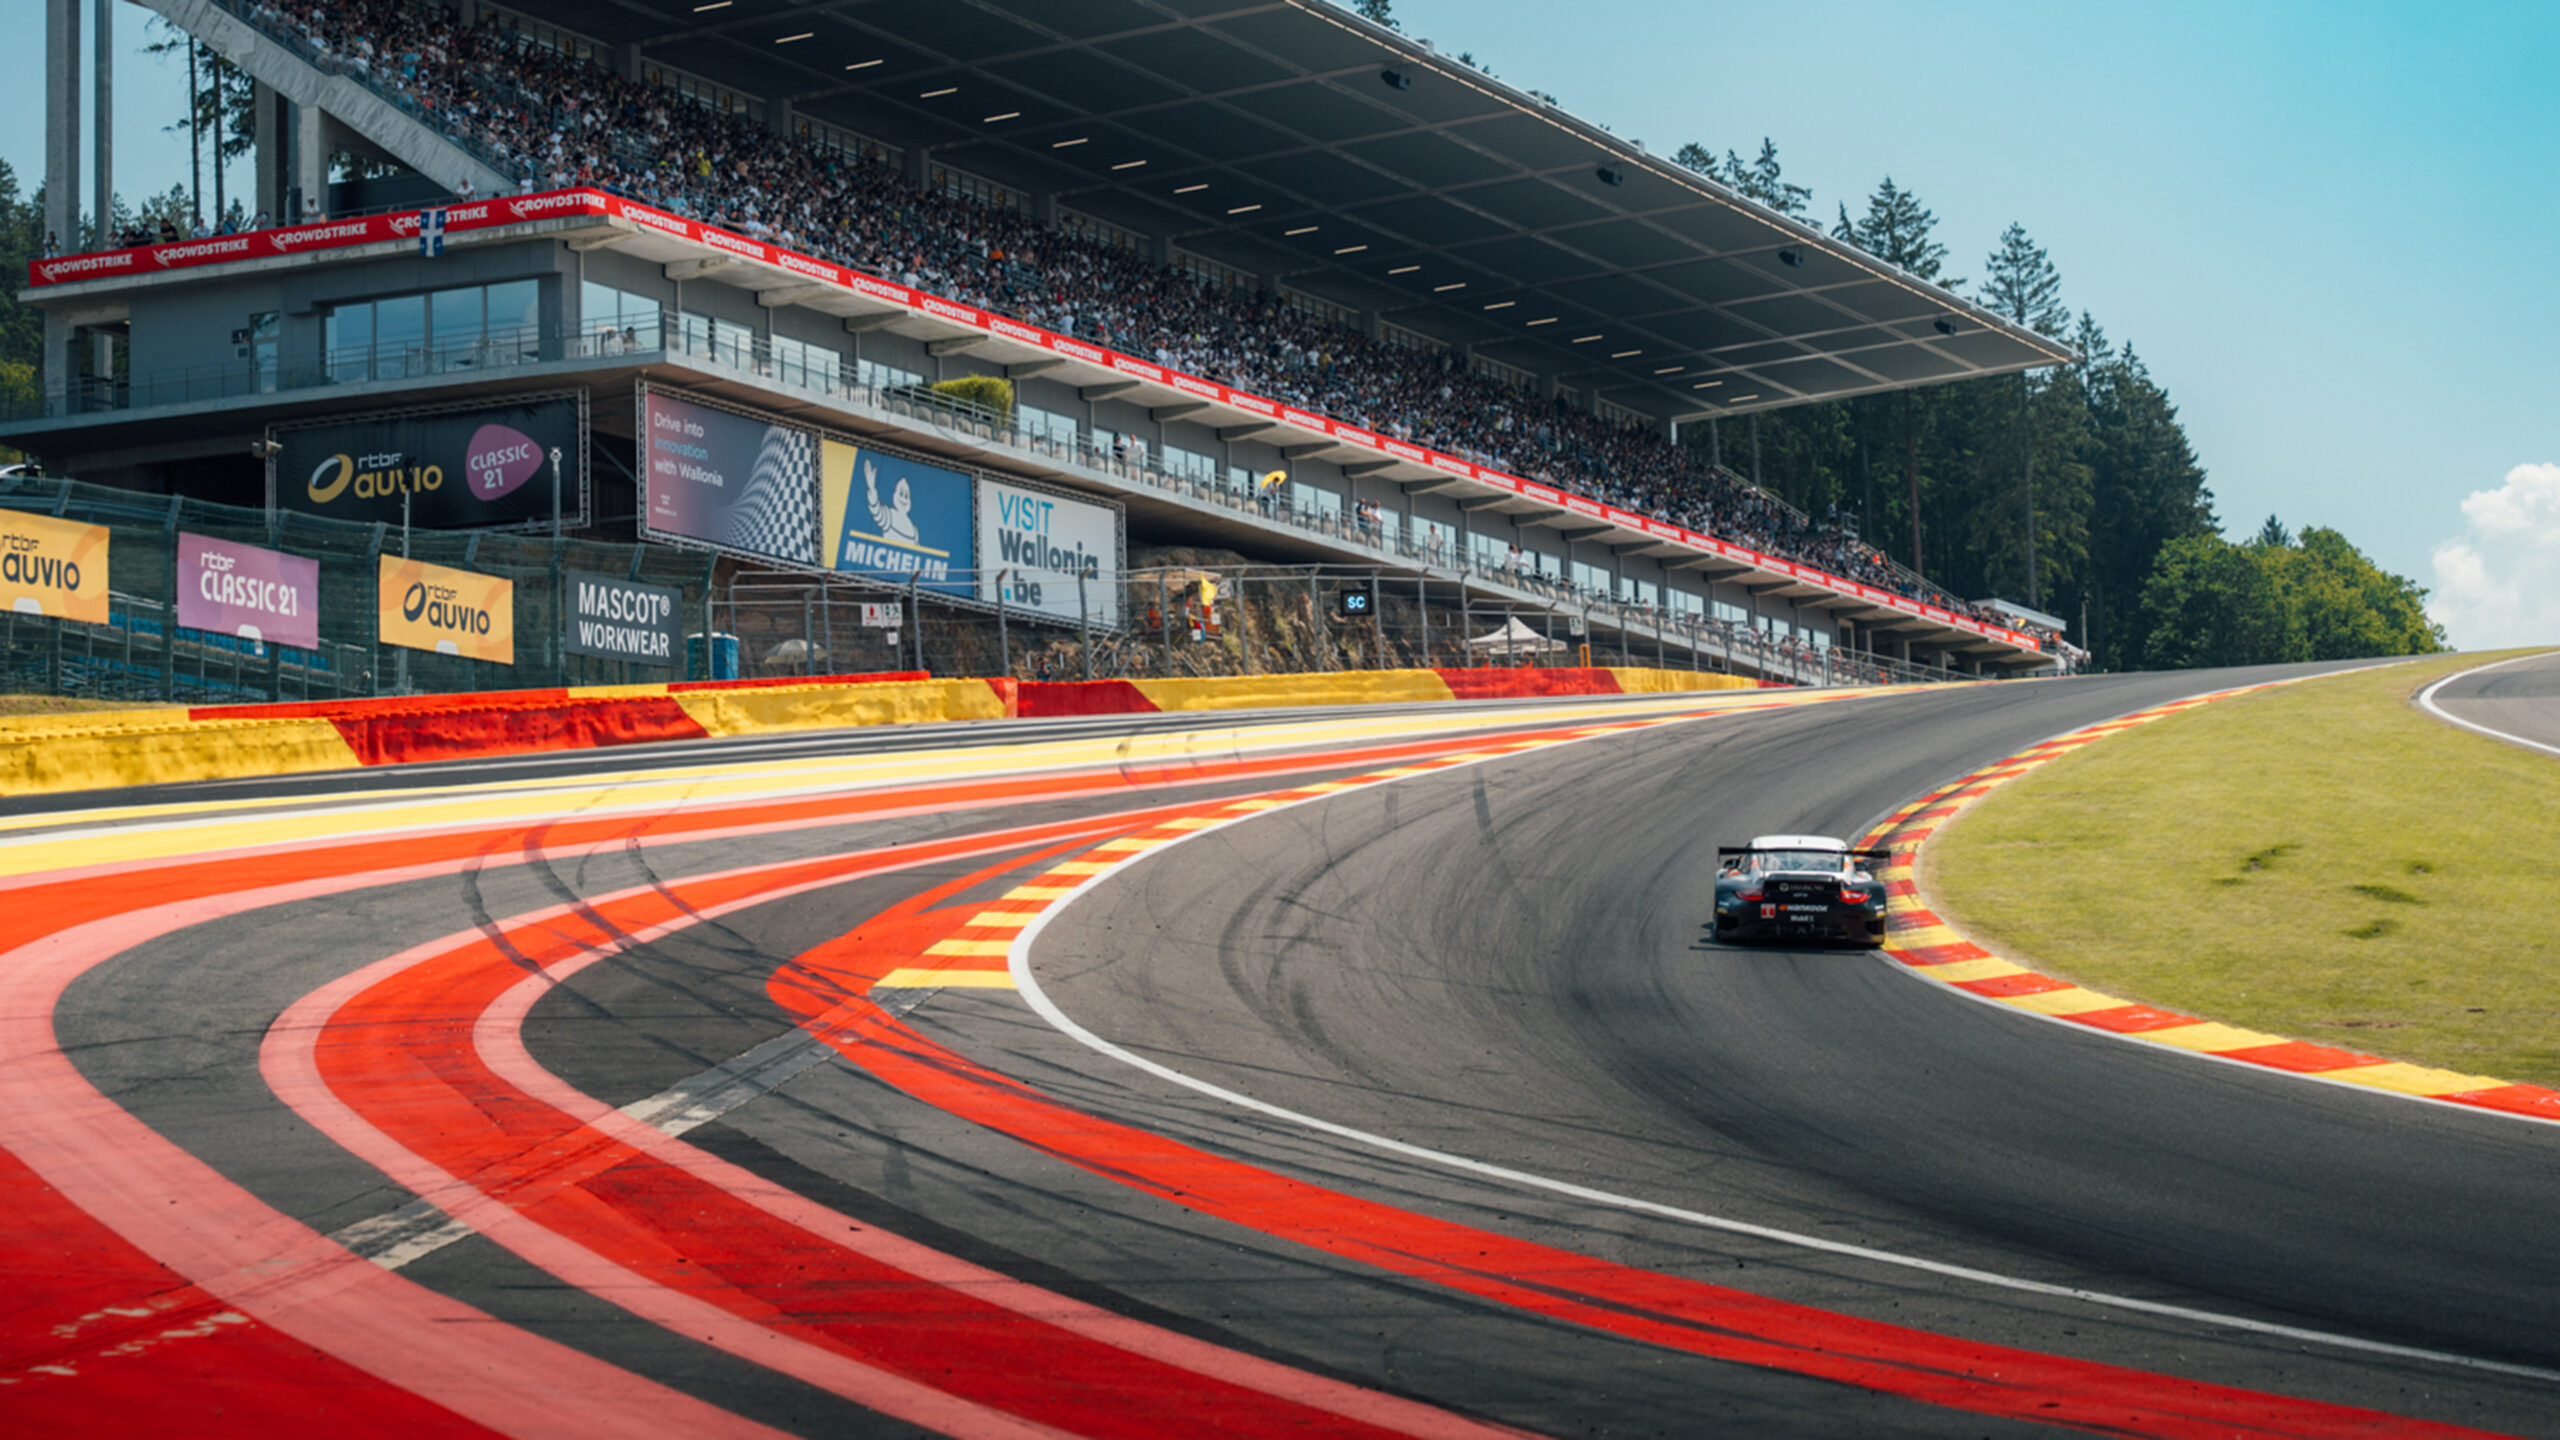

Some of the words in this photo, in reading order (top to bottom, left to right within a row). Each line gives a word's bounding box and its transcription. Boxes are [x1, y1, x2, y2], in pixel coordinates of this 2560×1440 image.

[516, 192, 606, 212] CROWDSTRIKE
[396, 205, 489, 228] CROSTRIKE
[624, 204, 688, 235] CROWDSTRIKE
[277, 222, 367, 246] CROWDSTRIKE
[703, 229, 765, 260] CROWDSTRIKE
[160, 238, 249, 261] CROWDSTRIKE
[46, 253, 133, 275] CROWDSTRIKE
[780, 254, 839, 282] CROWDSTRIKE
[854, 276, 910, 303] CROWDSTRIKE
[654, 412, 682, 433] Drive
[684, 418, 705, 438] into
[358, 452, 402, 470] rtbf
[470, 443, 530, 471] CLASSIC
[654, 434, 708, 462] innovation
[484, 467, 505, 490] 21
[654, 458, 677, 477] with
[679, 461, 724, 488] Wallonia
[998, 490, 1055, 534] VISIT
[2, 533, 40, 552] rtbf
[999, 527, 1099, 581] Wallonia
[2, 552, 81, 591] auvio
[201, 551, 236, 571] rtbf
[844, 540, 949, 582] MICHELIN
[200, 569, 276, 613] CLASSIC
[278, 584, 298, 617] 21
[427, 584, 458, 601] rtbf
[1346, 595, 1366, 609] SC
[427, 600, 491, 635] auvio
[578, 620, 670, 658] WORKWEAR
